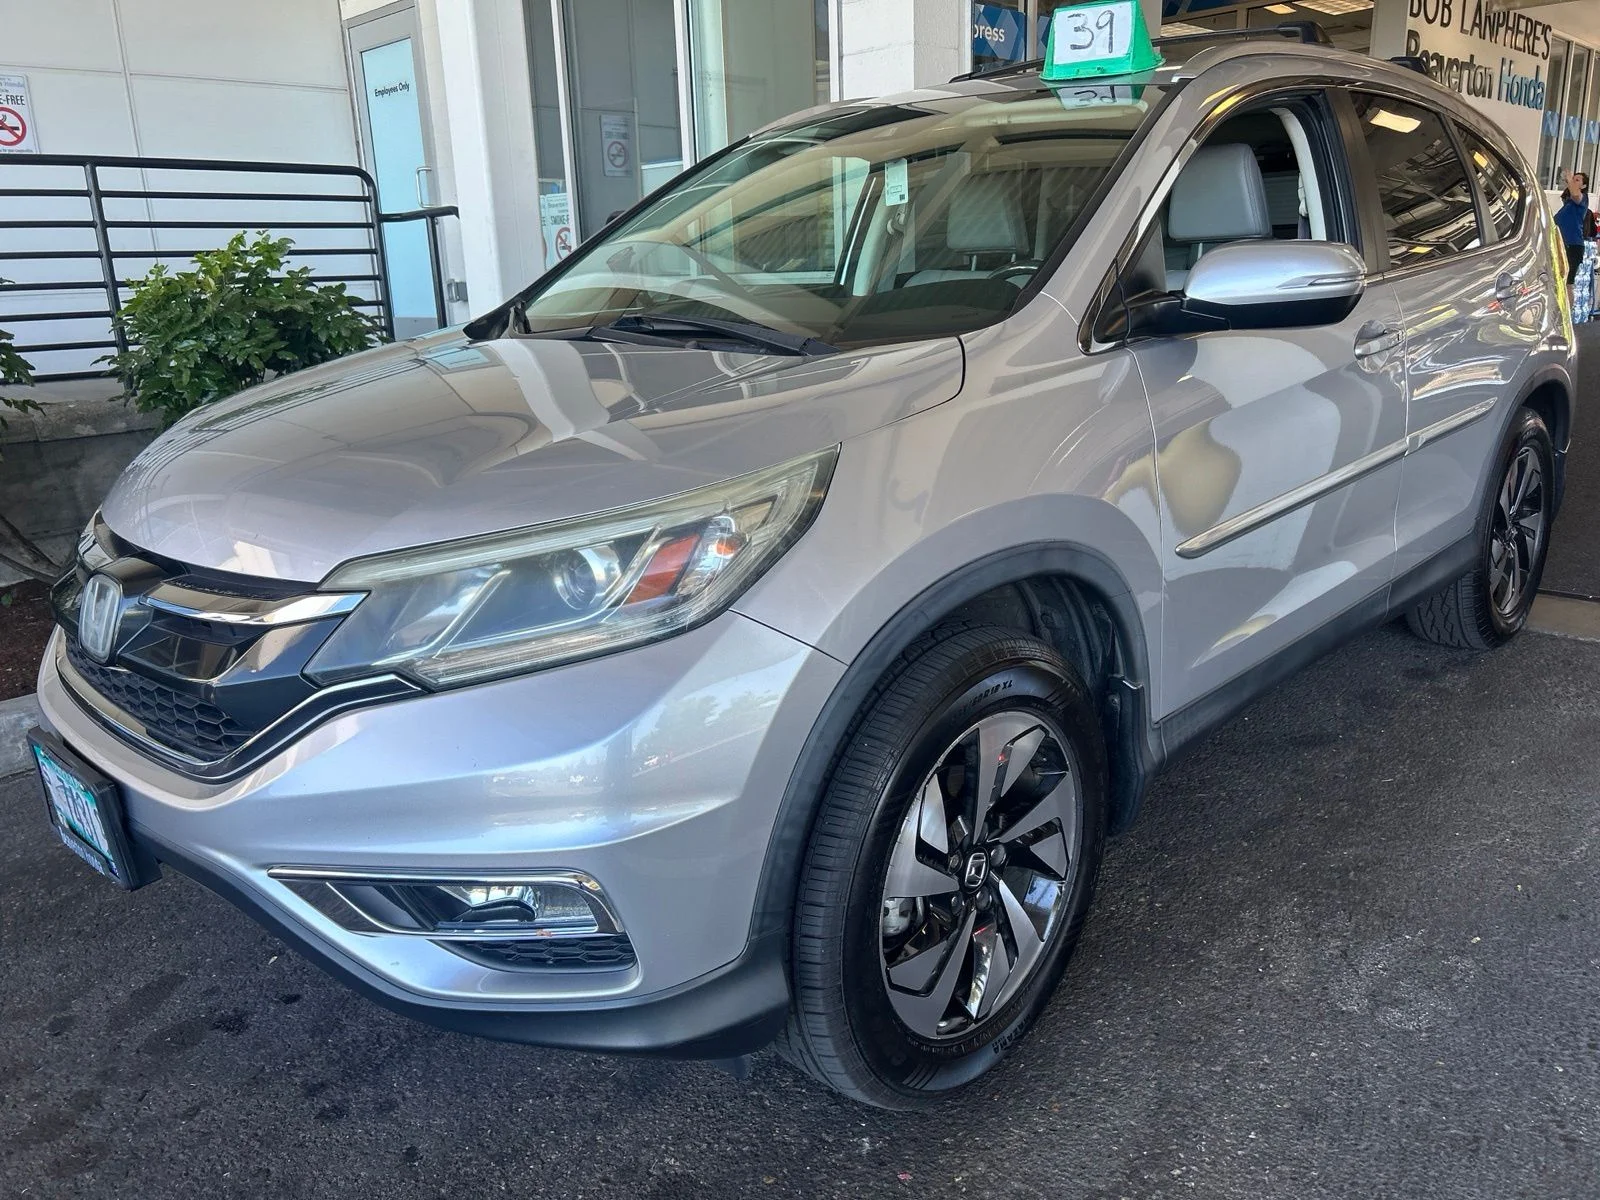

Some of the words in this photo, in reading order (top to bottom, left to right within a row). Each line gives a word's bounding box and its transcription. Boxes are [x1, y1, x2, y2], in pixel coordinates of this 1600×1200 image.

[1067, 9, 1115, 53] 39
[374, 86, 398, 97] Employees
[398, 82, 410, 91] Only
[1497, 57, 1545, 110] Honda
